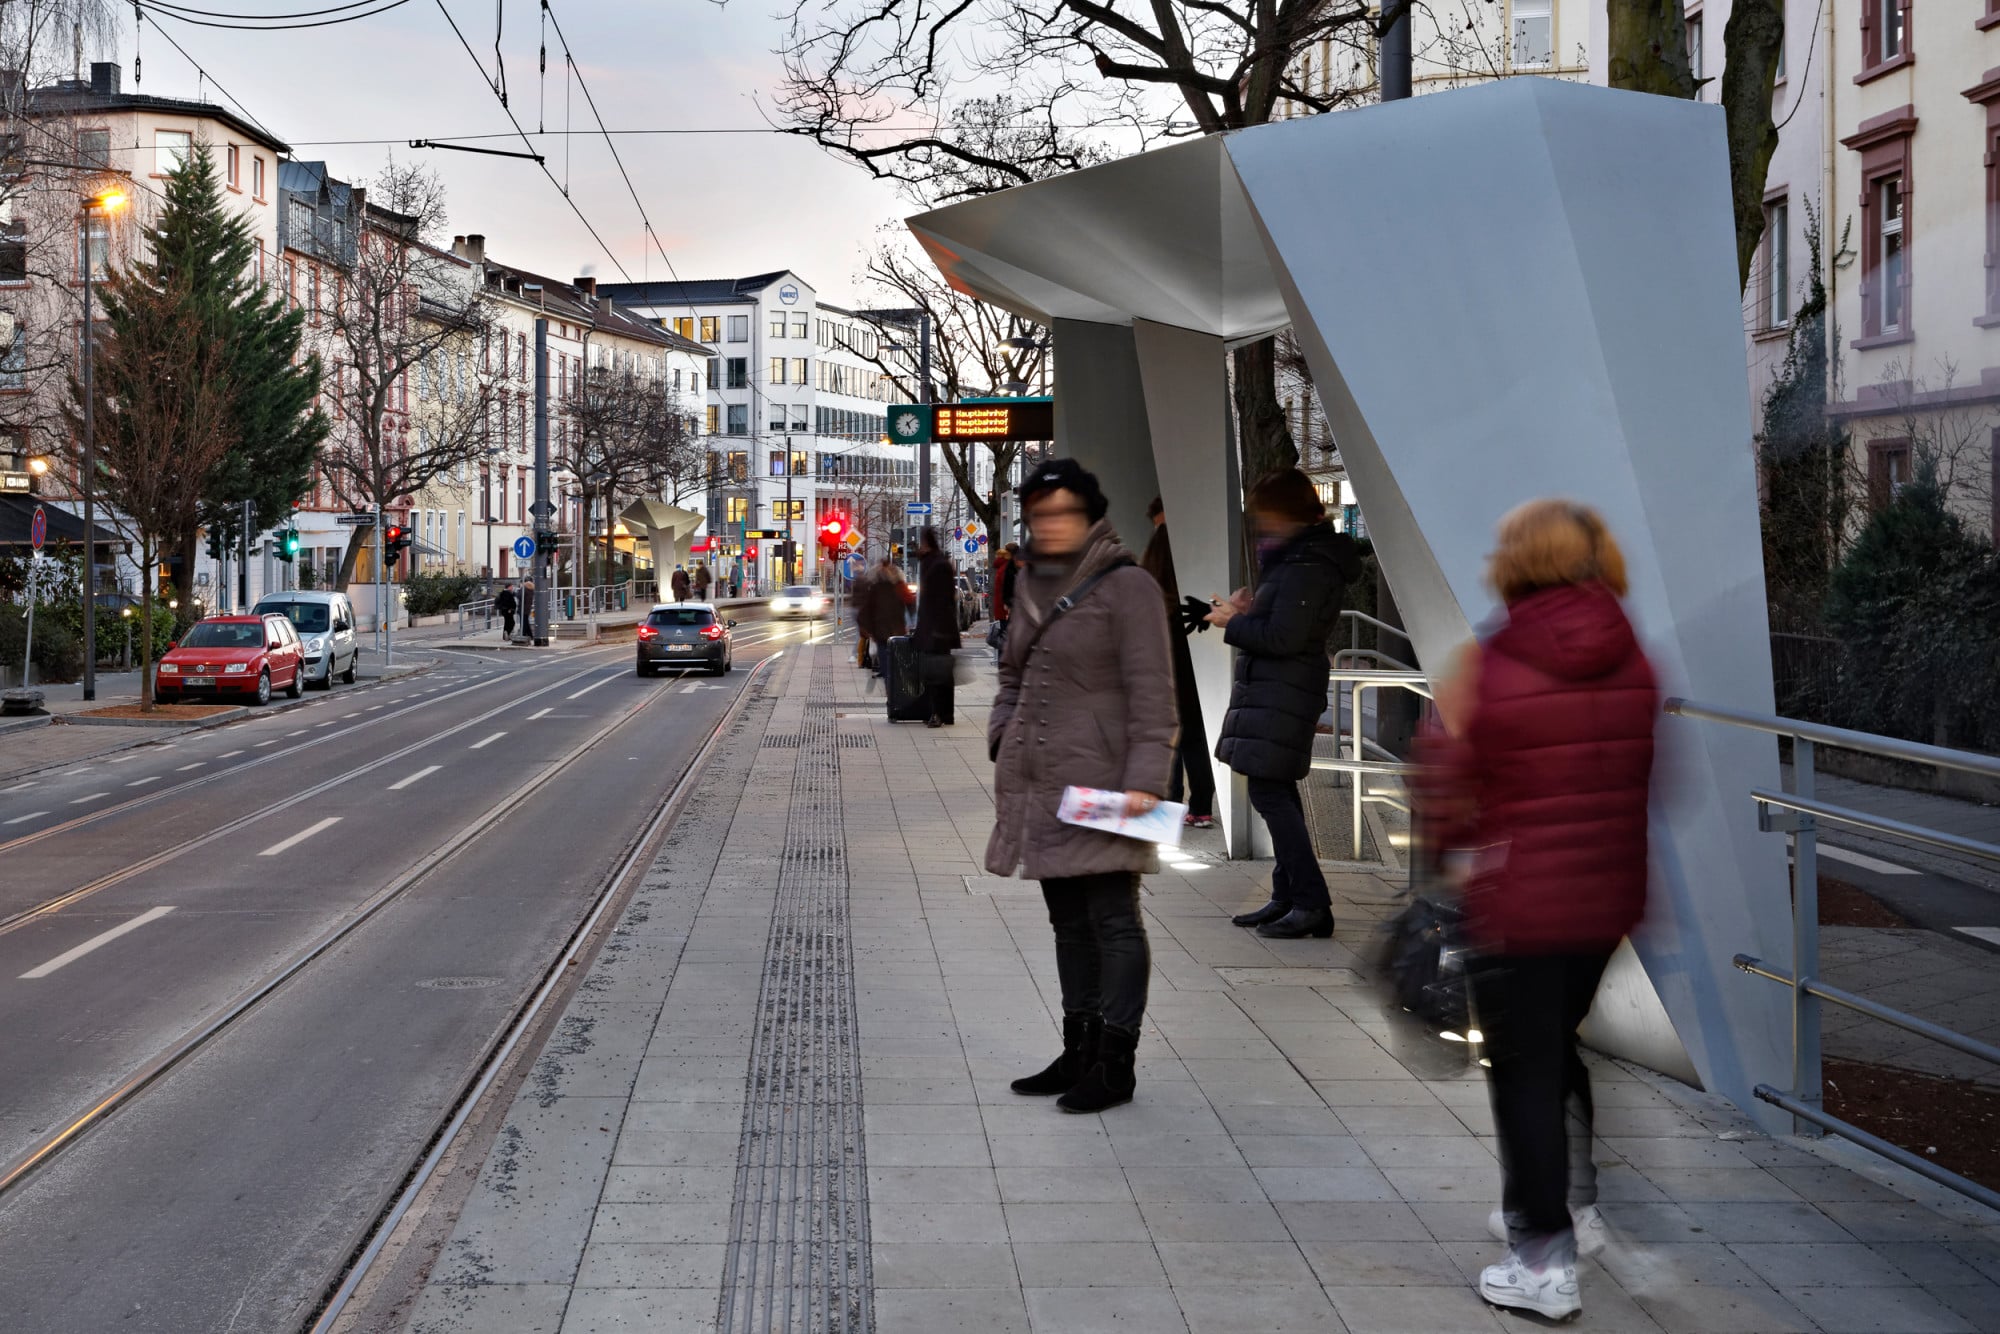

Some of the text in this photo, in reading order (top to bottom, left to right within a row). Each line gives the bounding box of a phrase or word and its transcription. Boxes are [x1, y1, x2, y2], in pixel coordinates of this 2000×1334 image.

[956, 409, 1009, 418] Hauptbahnhof
[956, 418, 1009, 427] Hauptbahnhof
[956, 426, 1009, 435] Hauptbahnhof
